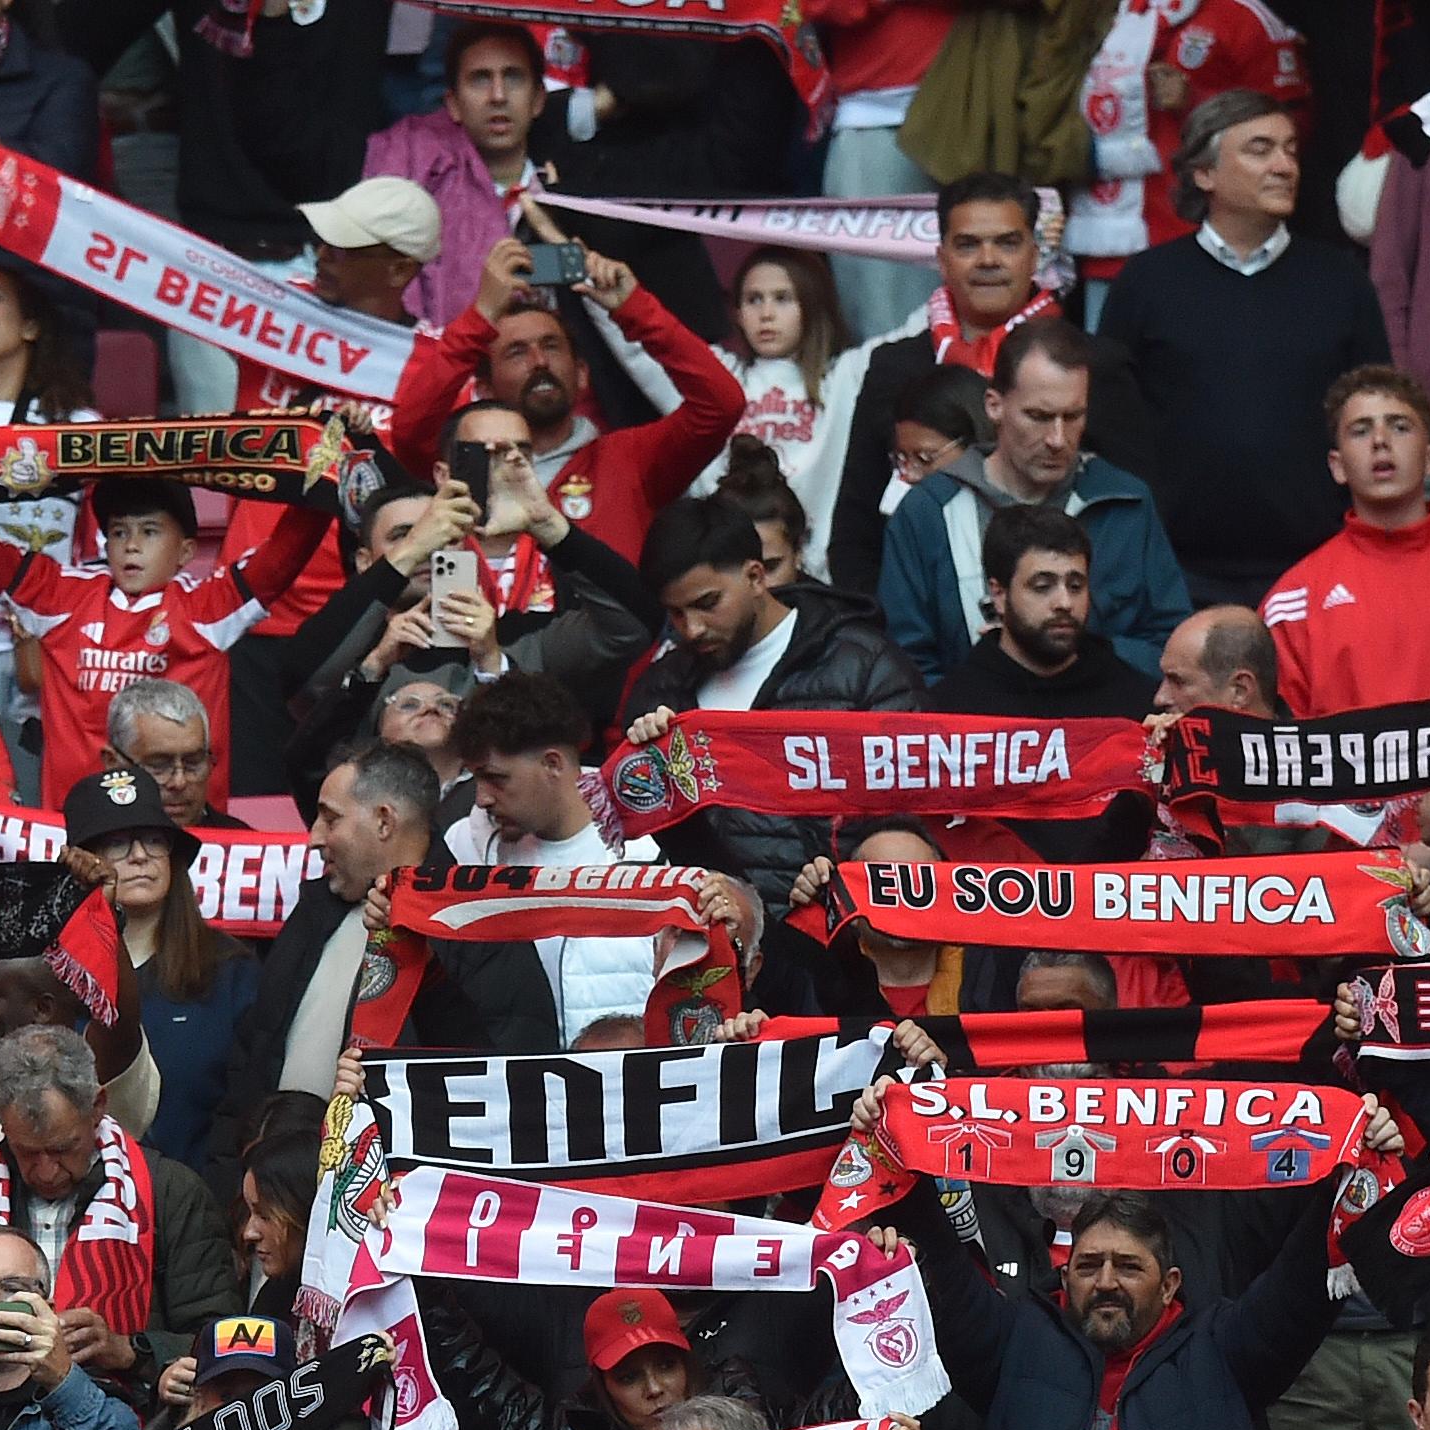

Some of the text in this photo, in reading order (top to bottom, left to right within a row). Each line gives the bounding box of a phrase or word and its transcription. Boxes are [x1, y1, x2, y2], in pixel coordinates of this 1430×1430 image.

[763, 209, 941, 241] BENFIC
[56, 427, 304, 468] BENFICA
[784, 728, 1071, 791] SL BENFICA
[869, 863, 1334, 925] EU SOU BENFICA
[910, 1080, 1324, 1126] S.L. BENFICA
[957, 1142, 1296, 1179] 1 9 0 4
